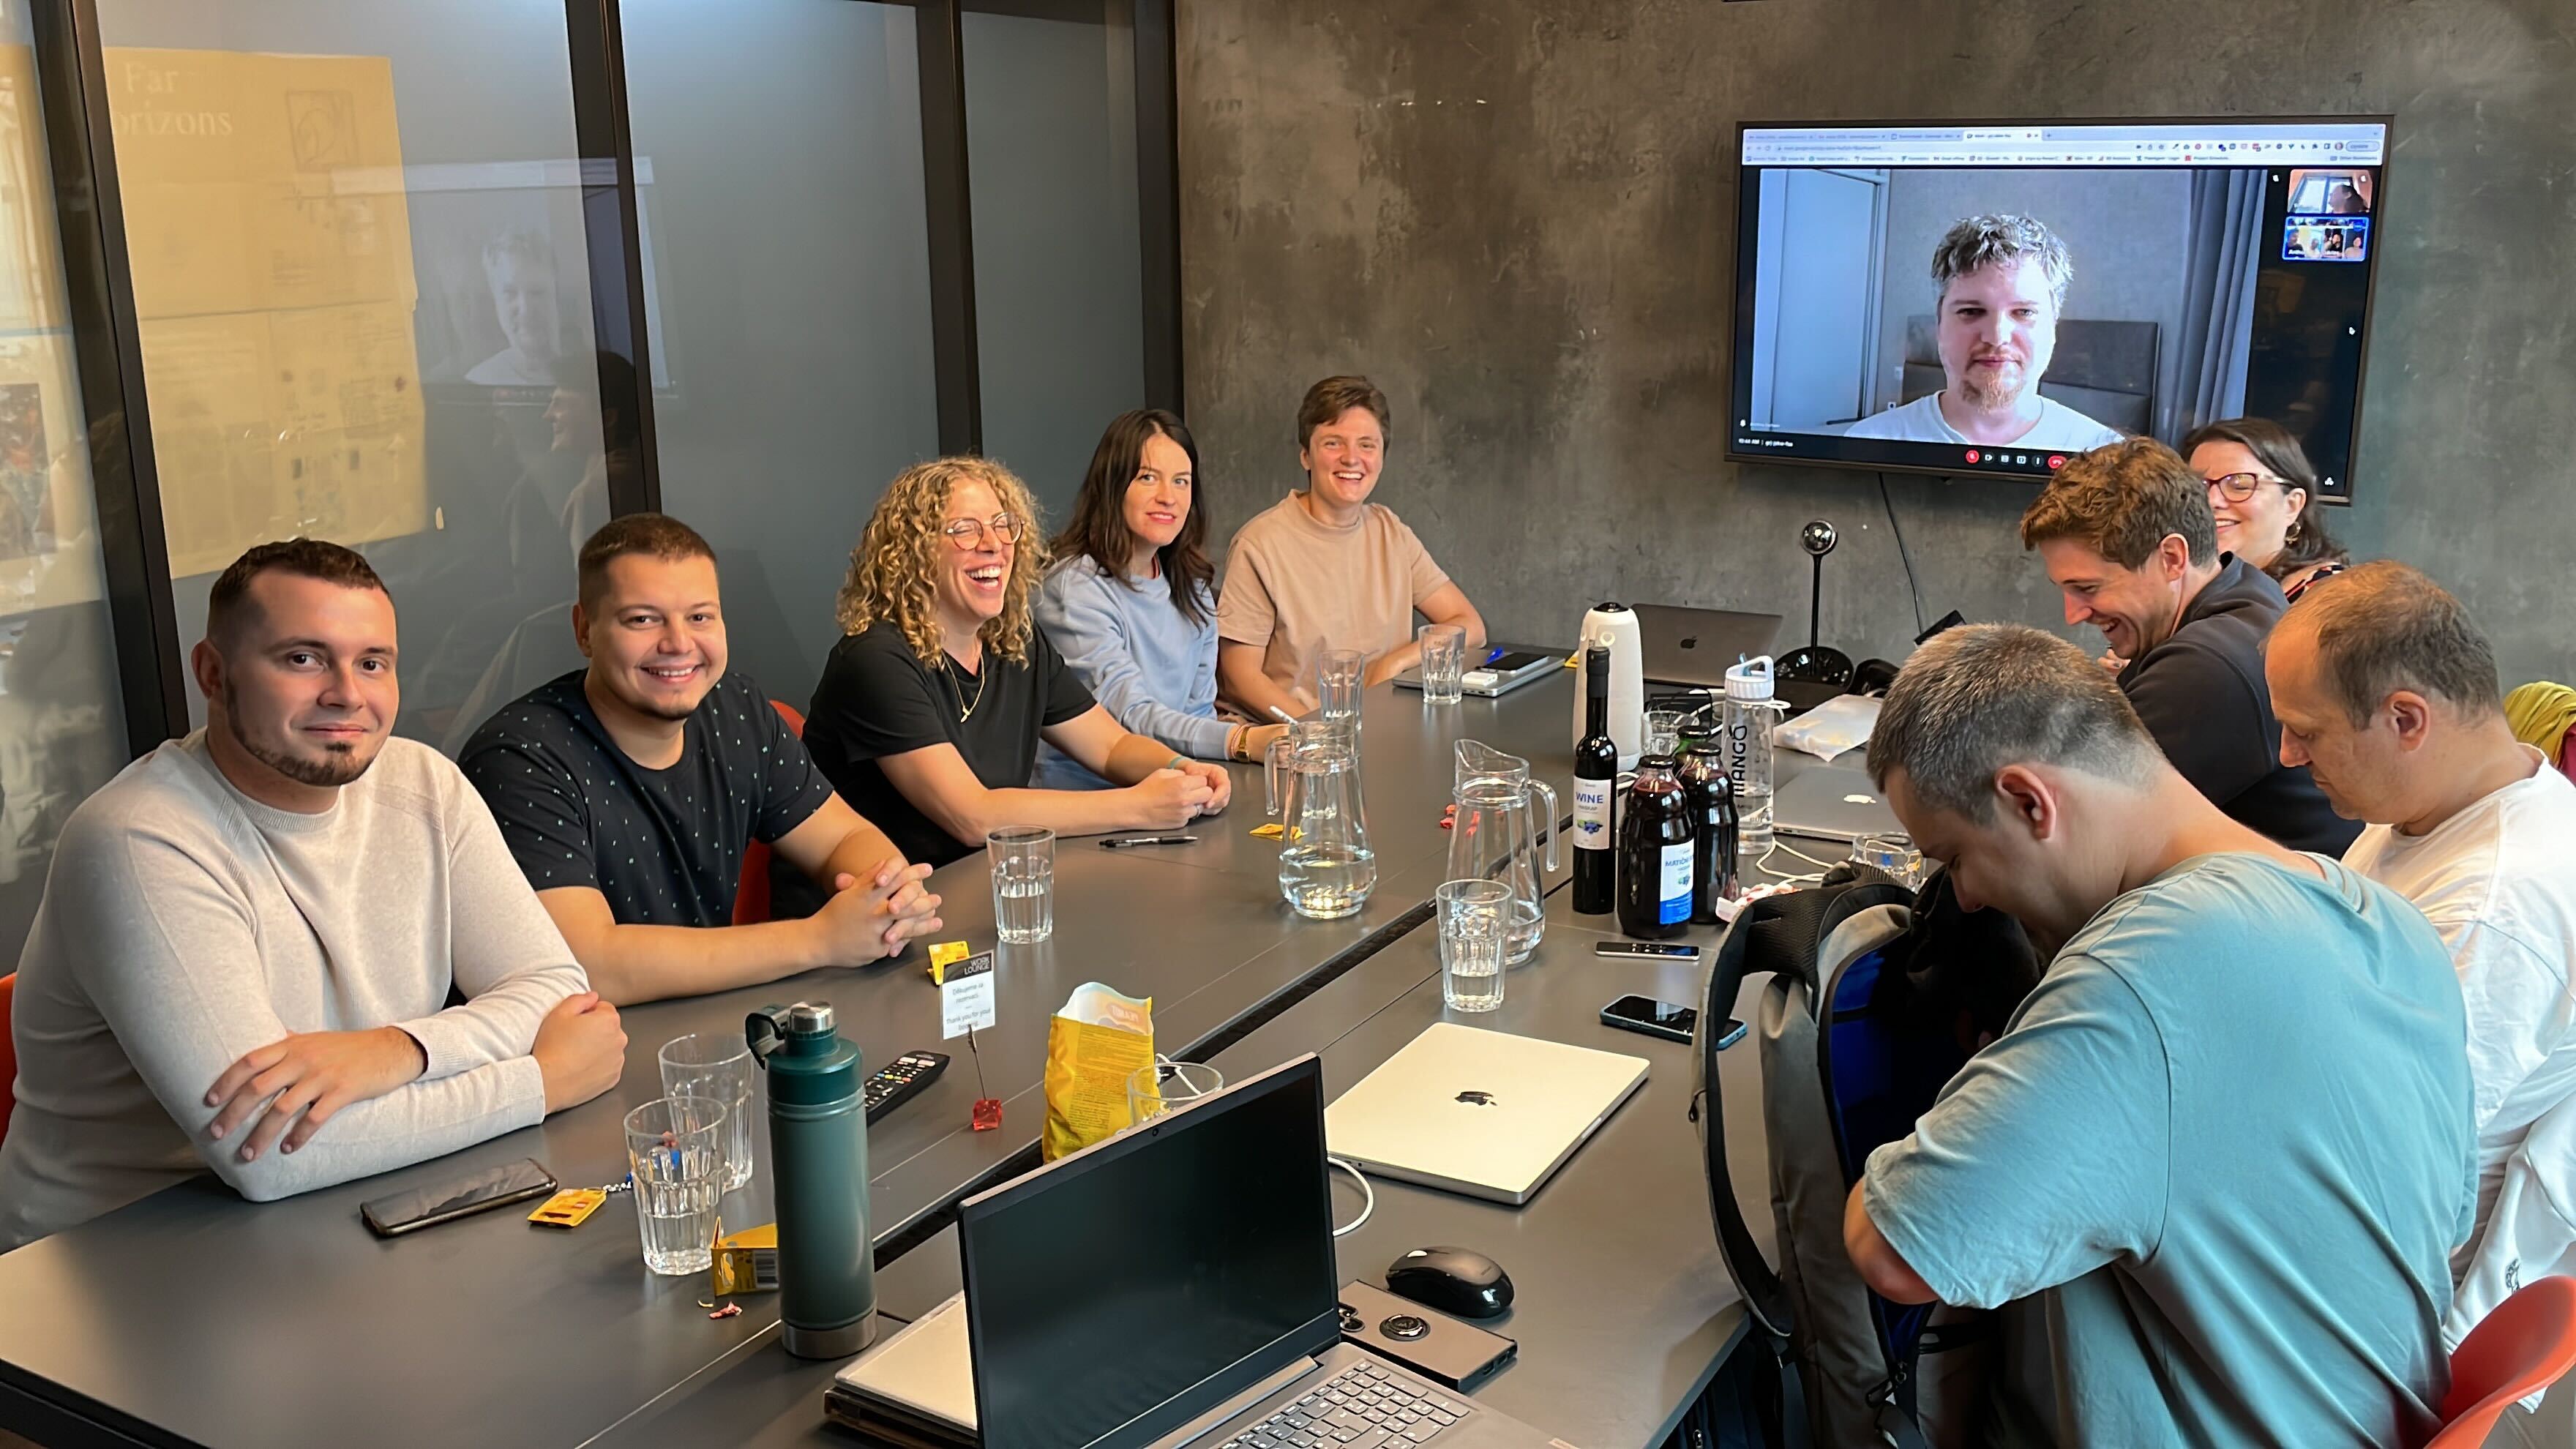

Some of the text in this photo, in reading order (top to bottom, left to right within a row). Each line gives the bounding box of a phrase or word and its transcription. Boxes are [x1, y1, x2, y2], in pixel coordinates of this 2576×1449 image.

[125, 61, 180, 94] Far
[115, 101, 233, 137] orizons
[1576, 792, 1603, 804] WINE
[970, 956, 990, 967] WORK
[964, 964, 990, 975] LOUNGE
[946, 1016, 961, 1025] Thank
[962, 1014, 972, 1022] you
